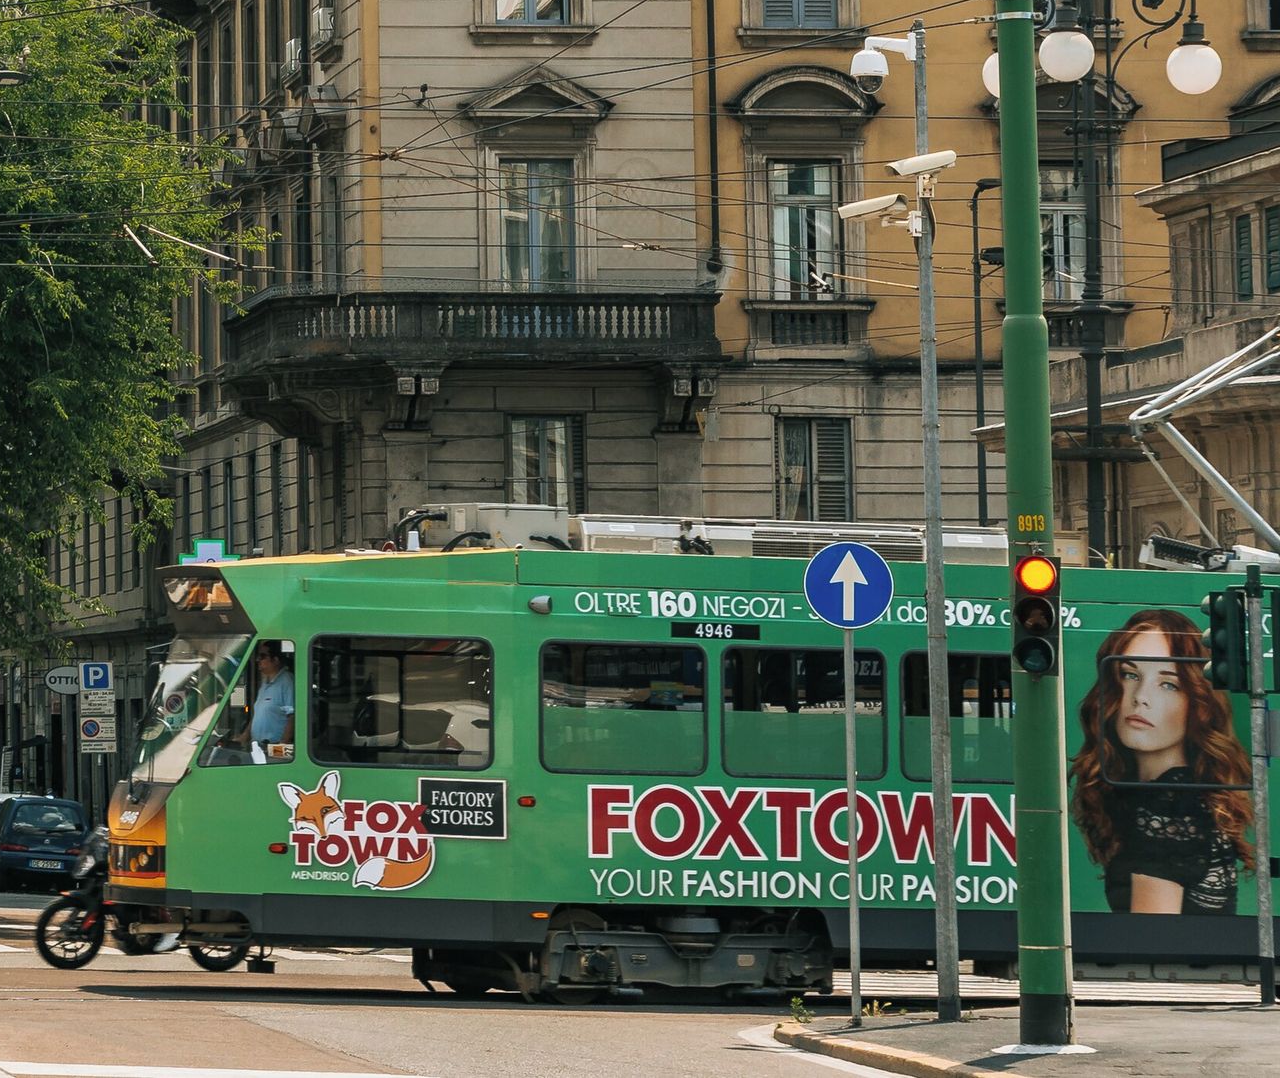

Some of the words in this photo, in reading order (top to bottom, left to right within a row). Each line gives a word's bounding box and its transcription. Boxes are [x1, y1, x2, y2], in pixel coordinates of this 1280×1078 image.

[1017, 514, 1045, 532] 8913
[574, 591, 642, 614] OLTRE
[647, 590, 697, 619] 160
[702, 595, 786, 619] NEGOZI
[694, 623, 734, 639] 4946
[48, 675, 80, 686] OTTIC
[89, 666, 104, 686] P
[430, 790, 496, 808] FACTORY
[342, 800, 430, 835] FOX
[429, 809, 495, 827] STORES
[586, 783, 1018, 867] FOXTOWN
[290, 833, 430, 866] TOWN
[290, 870, 351, 883] MENDRISIO
[589, 867, 675, 898] YOUR
[681, 869, 823, 900] FASHION
[828, 872, 896, 902] OUR
